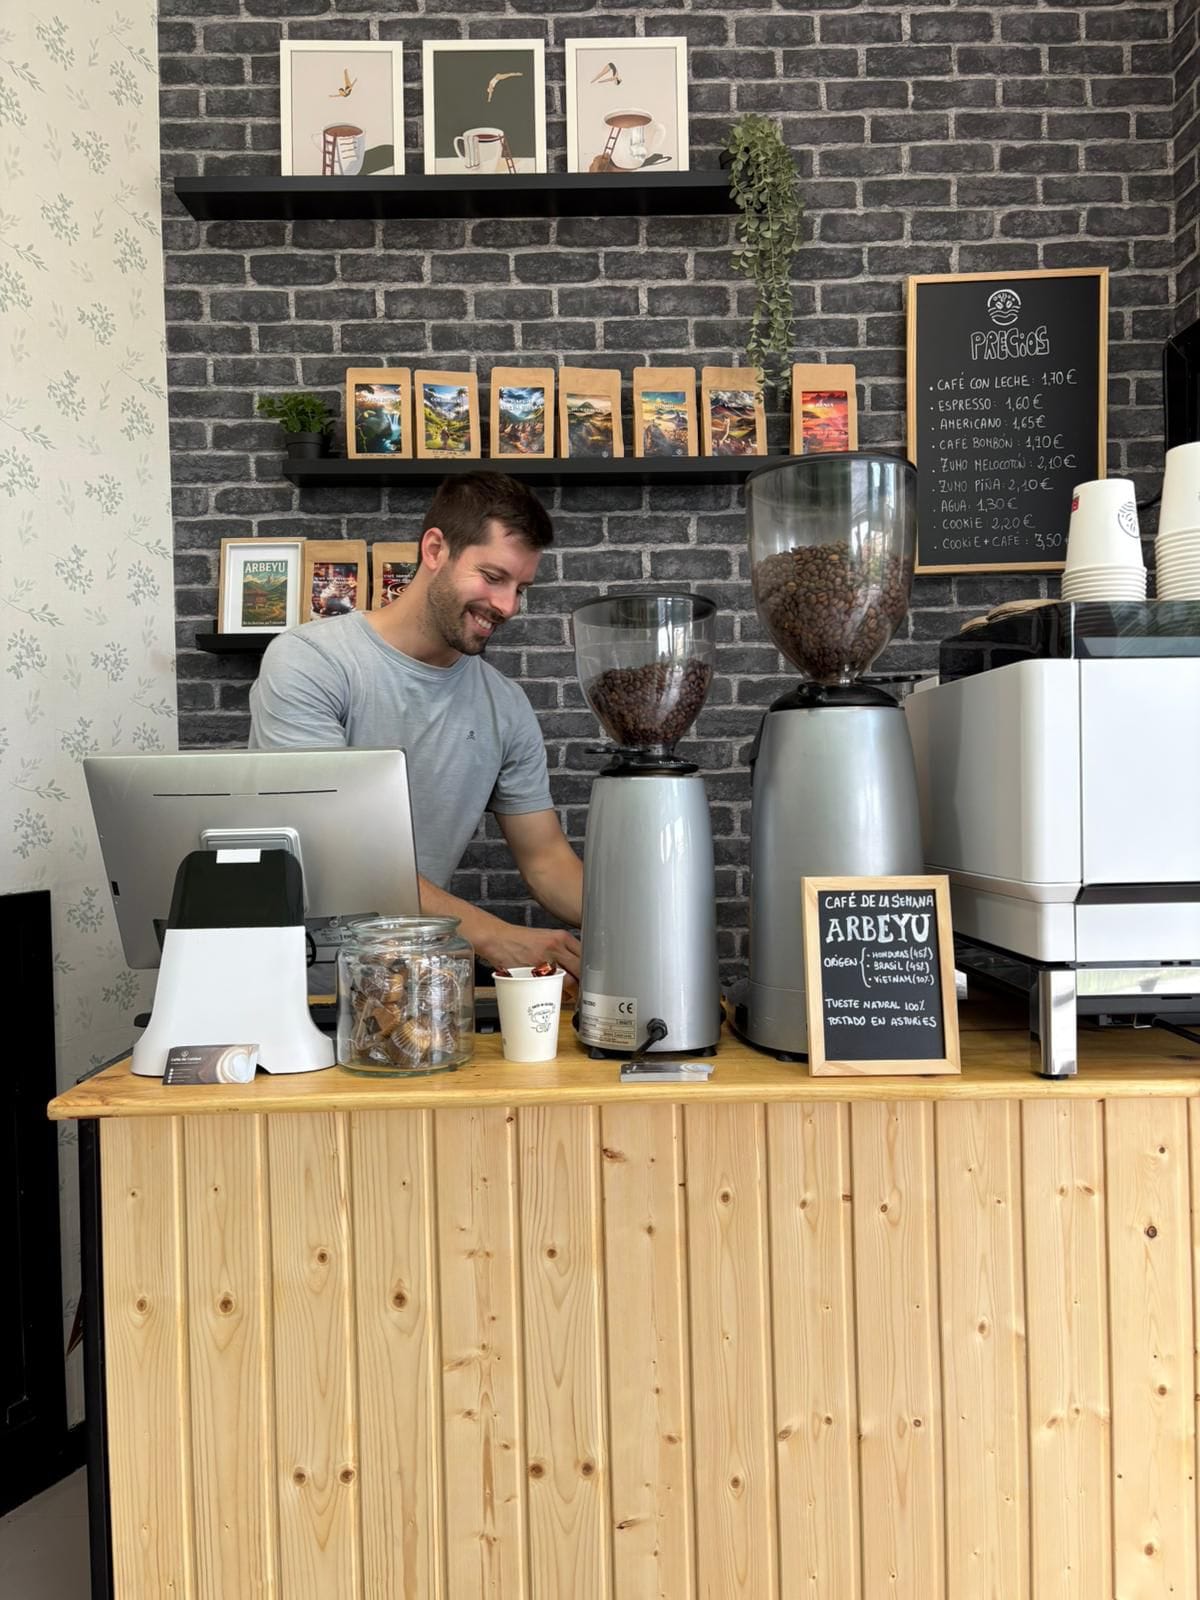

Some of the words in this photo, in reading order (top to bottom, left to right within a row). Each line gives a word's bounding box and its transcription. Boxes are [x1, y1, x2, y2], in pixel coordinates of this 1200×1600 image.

[970, 377, 990, 390] CON
[940, 457, 968, 473] ZUMO
[938, 480, 968, 493] ZUMO
[244, 561, 287, 573] ARBEYU
[825, 892, 857, 909] CAFÉ
[860, 894, 876, 908] DE
[879, 894, 890, 908] LA
[825, 913, 931, 944] ARBEYU
[825, 998, 860, 1009] TUESTE
[863, 999, 900, 1010] NATURAL
[904, 1000, 926, 1011] 100%
[827, 1016, 866, 1026] TOSTADO
[871, 1016, 886, 1026] EN
